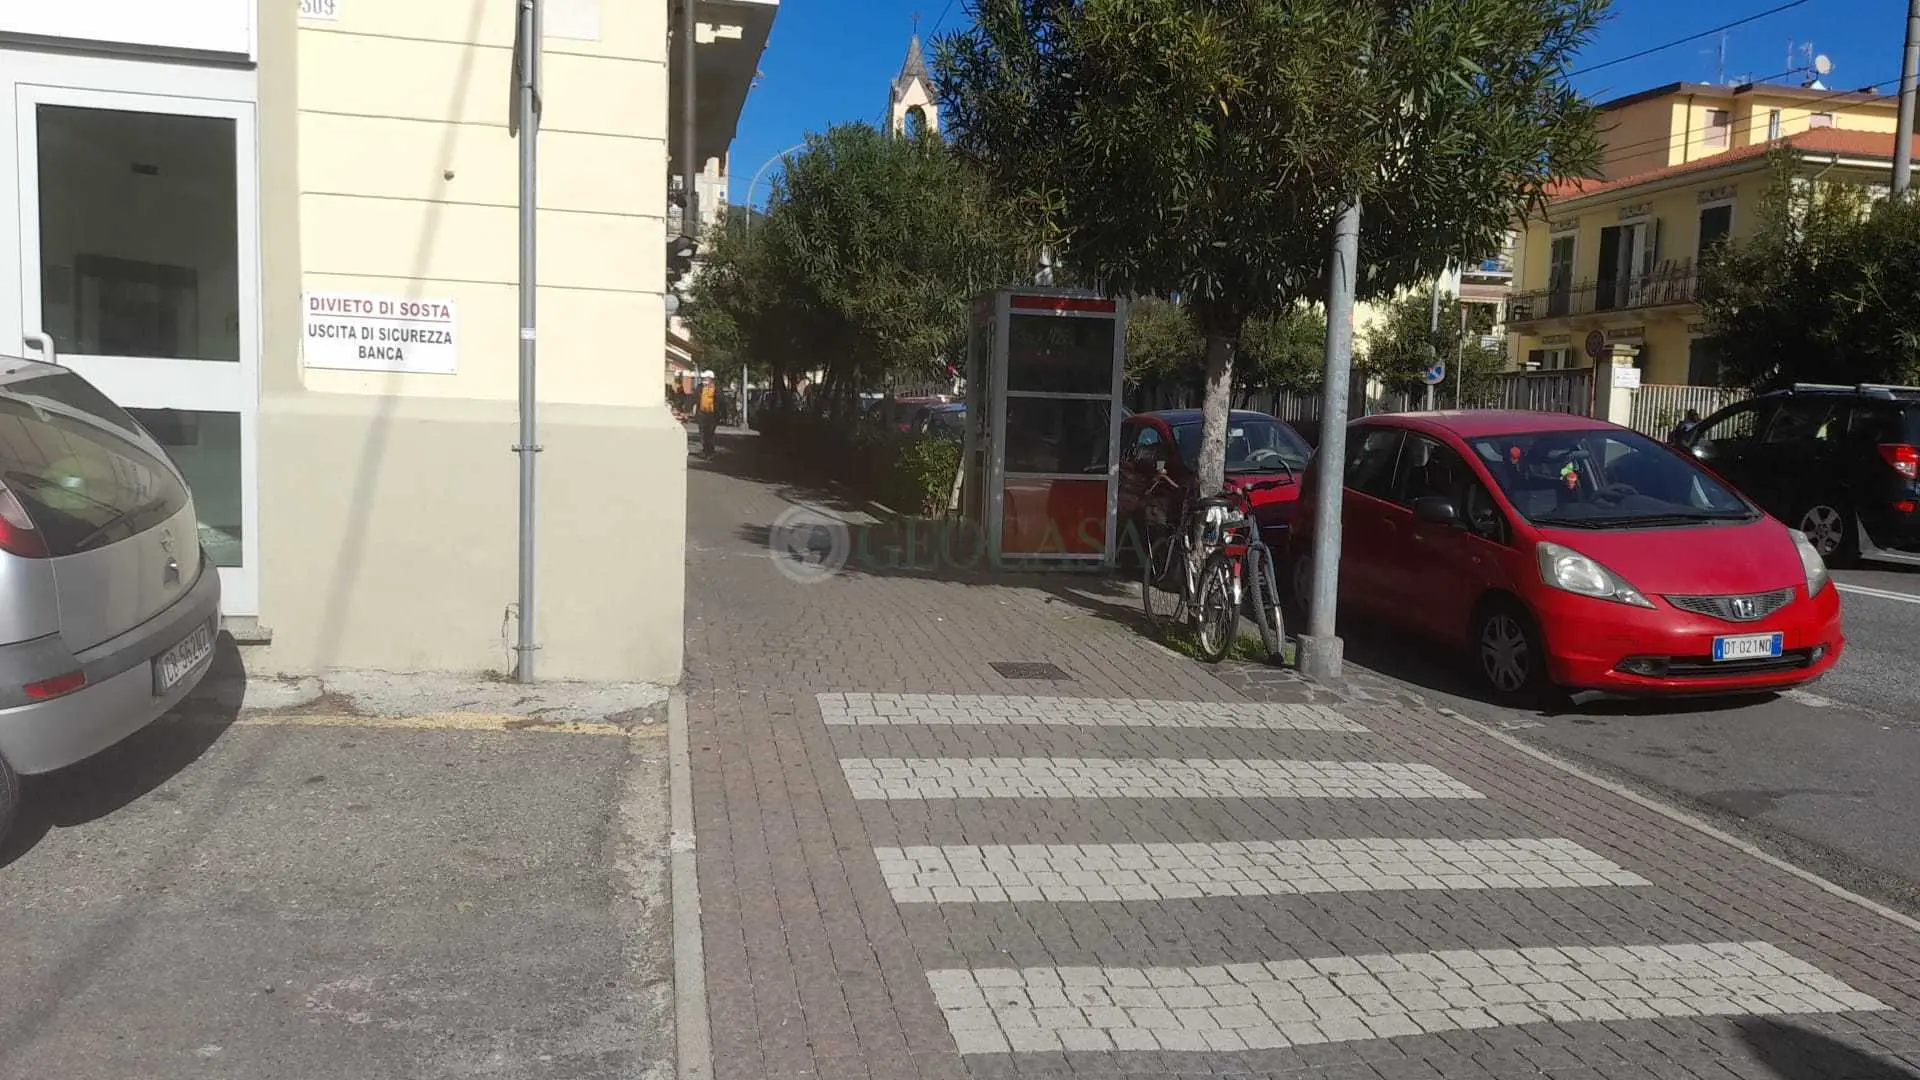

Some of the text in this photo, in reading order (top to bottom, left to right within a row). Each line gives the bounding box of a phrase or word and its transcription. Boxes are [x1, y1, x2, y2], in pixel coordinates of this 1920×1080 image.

[309, 296, 450, 318] DIVIETO DI SOSTA
[308, 323, 452, 344] USCITA DI SICUREZZA
[358, 345, 404, 361] BANCA
